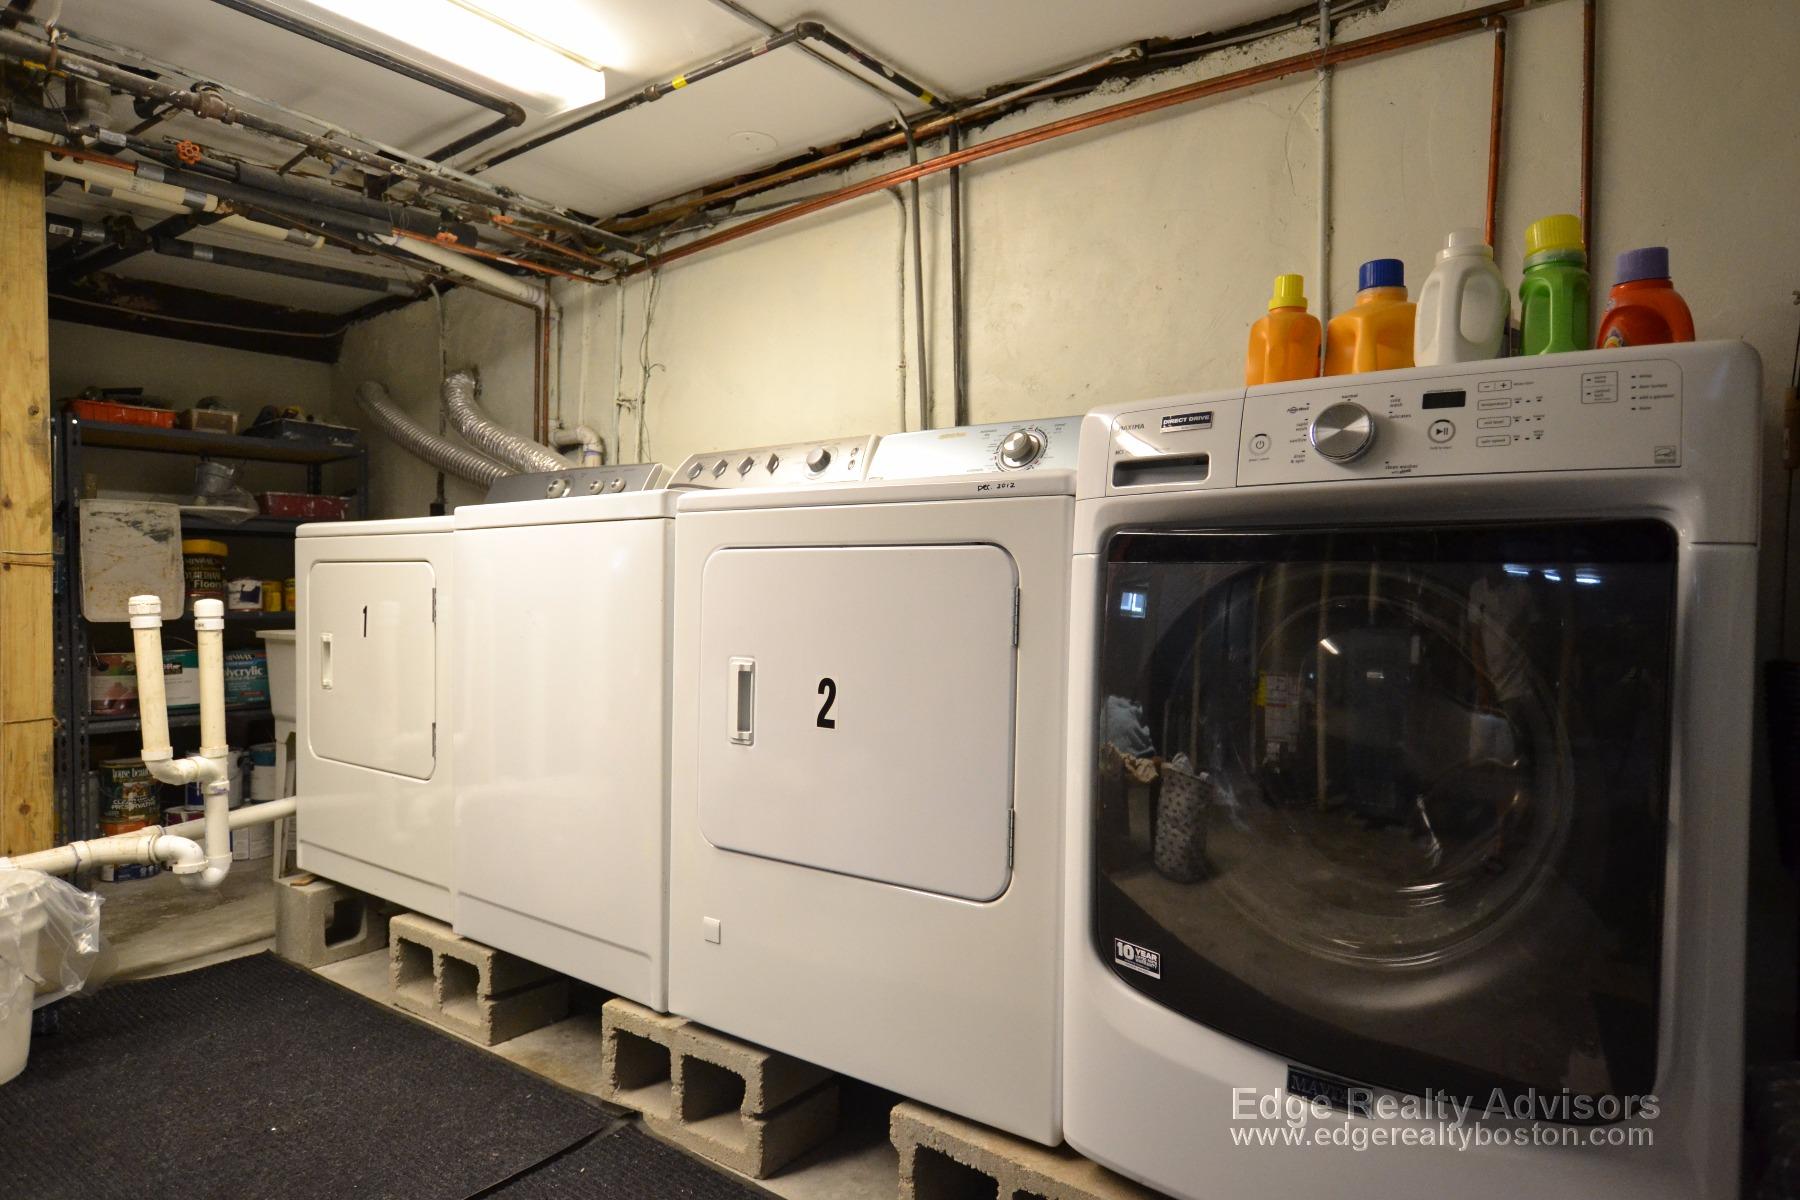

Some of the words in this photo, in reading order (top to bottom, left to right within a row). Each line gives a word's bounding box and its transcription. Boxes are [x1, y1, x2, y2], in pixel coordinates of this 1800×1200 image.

[1163, 417, 1187, 425] DIRECT
[1188, 414, 1210, 422] DRIVE
[362, 605, 368, 638] 1
[816, 677, 837, 729] 2
[1116, 941, 1135, 961] 10
[1135, 947, 1158, 962] YEAR
